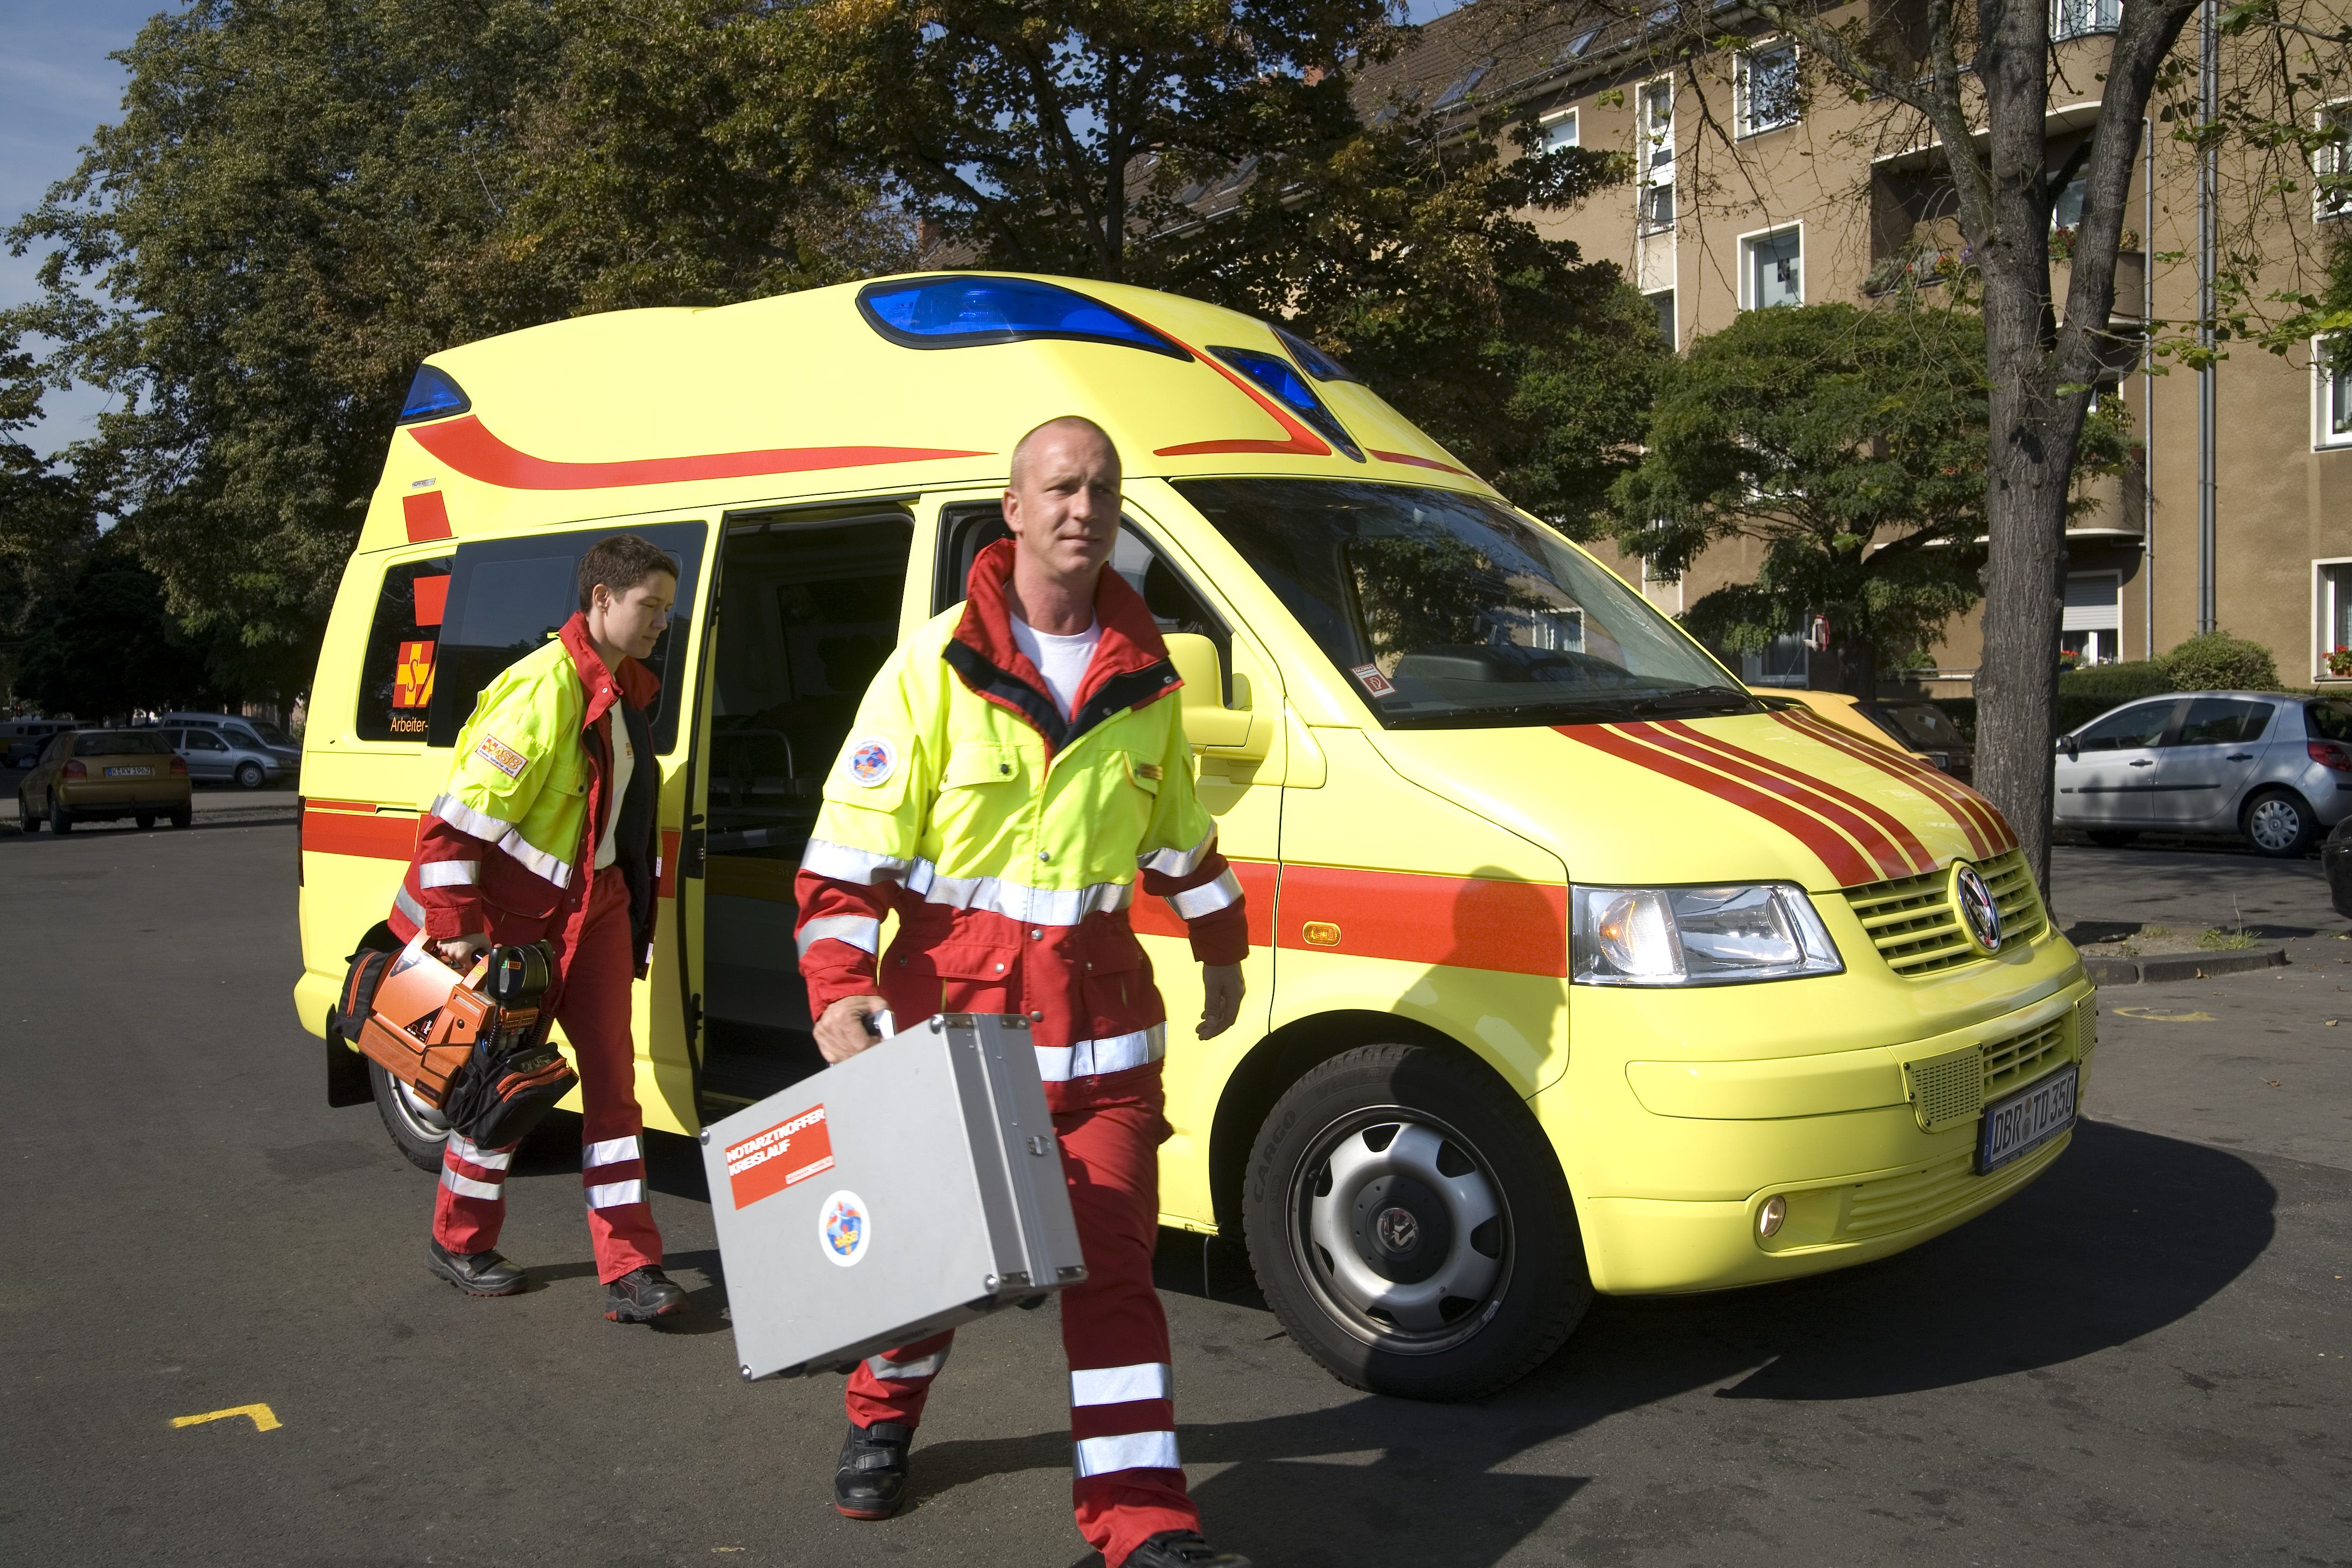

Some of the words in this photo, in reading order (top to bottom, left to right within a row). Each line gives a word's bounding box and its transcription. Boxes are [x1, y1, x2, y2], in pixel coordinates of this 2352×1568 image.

[390, 716, 429, 732] Arbeiter-
[488, 746, 523, 769] ASB
[726, 1108, 826, 1163] NOTARZTKOFFER
[1992, 1102, 2022, 1155] DBR
[2032, 1088, 2049, 1133] TD
[2050, 1074, 2074, 1123] 350
[728, 1138, 791, 1177] KREISLAUF
[1254, 1110, 1296, 1203] CARGO
